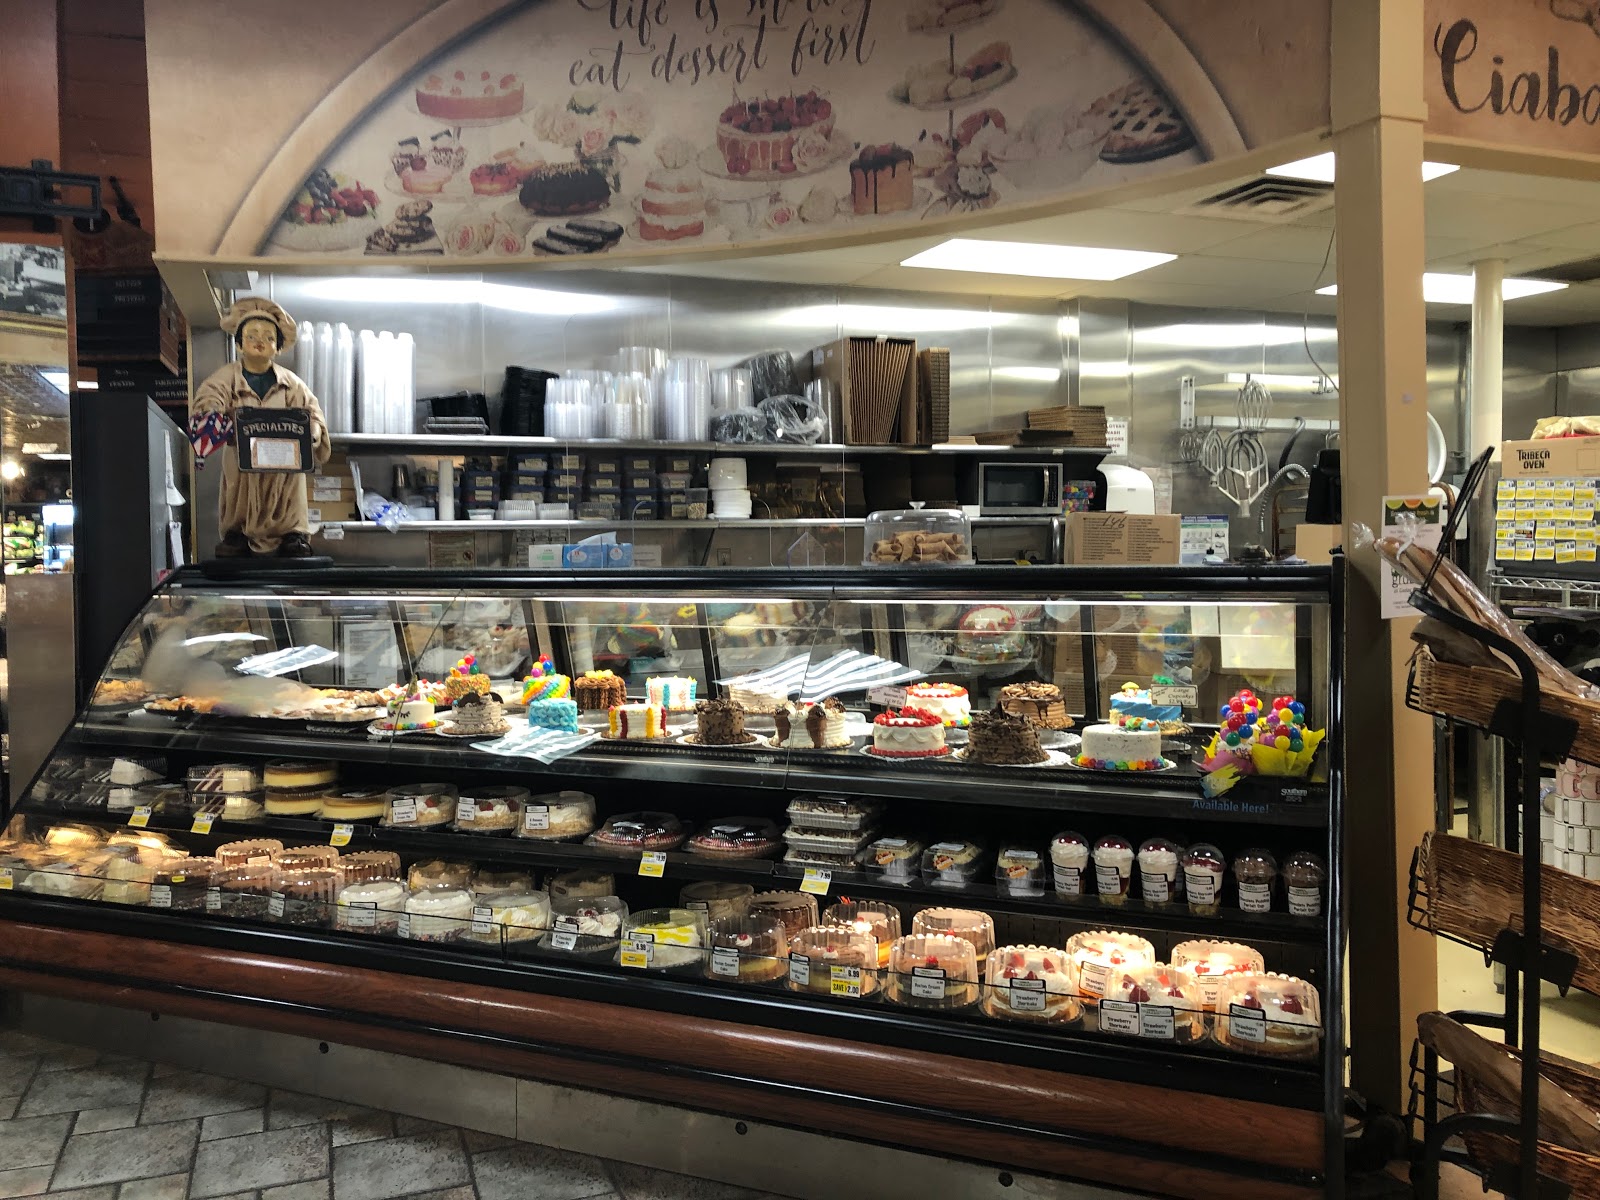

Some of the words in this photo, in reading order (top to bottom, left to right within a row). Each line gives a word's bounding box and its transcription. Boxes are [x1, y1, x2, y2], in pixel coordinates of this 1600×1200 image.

[569, 40, 645, 92] eat
[651, 14, 774, 85] dessert
[791, 0, 877, 77] first
[242, 421, 305, 436] SPECIALTIES
[1516, 449, 1550, 461] TRIBECA
[1523, 460, 1545, 469] OVEN
[1192, 799, 1239, 812] Available
[1241, 802, 1270, 814] Here!
[832, 983, 844, 992] SAVE
[847, 985, 859, 994] 2.00
[1107, 1016, 1131, 1025] Strawberry
[1109, 1022, 1130, 1030] Shortcake
[1143, 1022, 1167, 1030] Strawberry
[1235, 1023, 1258, 1032] Strawberry
